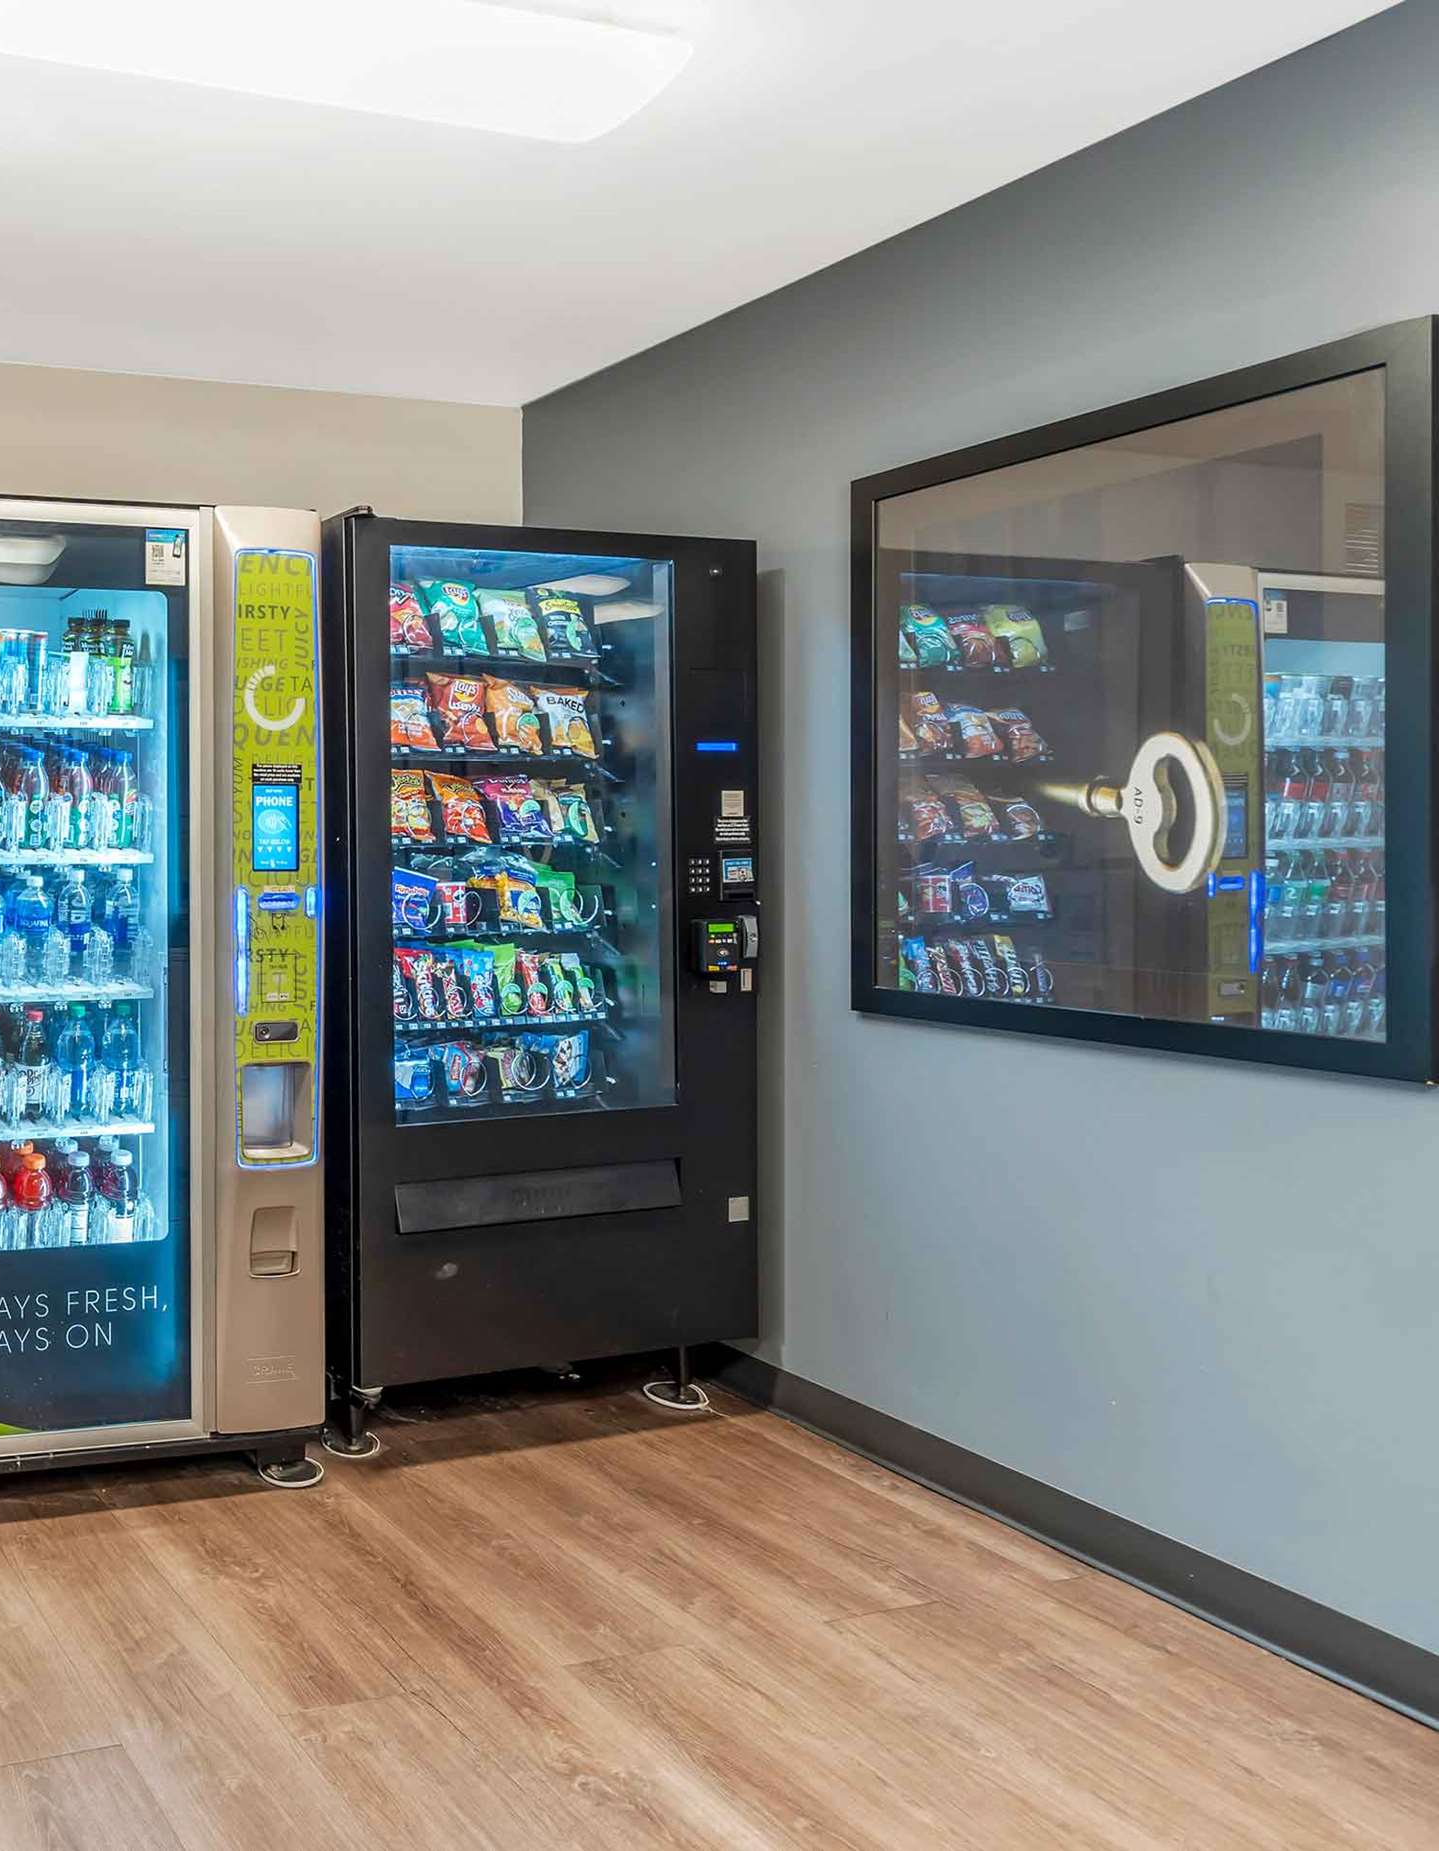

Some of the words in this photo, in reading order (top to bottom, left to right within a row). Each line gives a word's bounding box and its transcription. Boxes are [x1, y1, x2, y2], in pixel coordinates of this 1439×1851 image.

[546, 696, 584, 713] BAKED
[256, 796, 294, 807] PHONE
[1133, 786, 1144, 825] AD-9
[66, 1285, 169, 1316] FRESH,
[65, 1321, 113, 1349] ON
